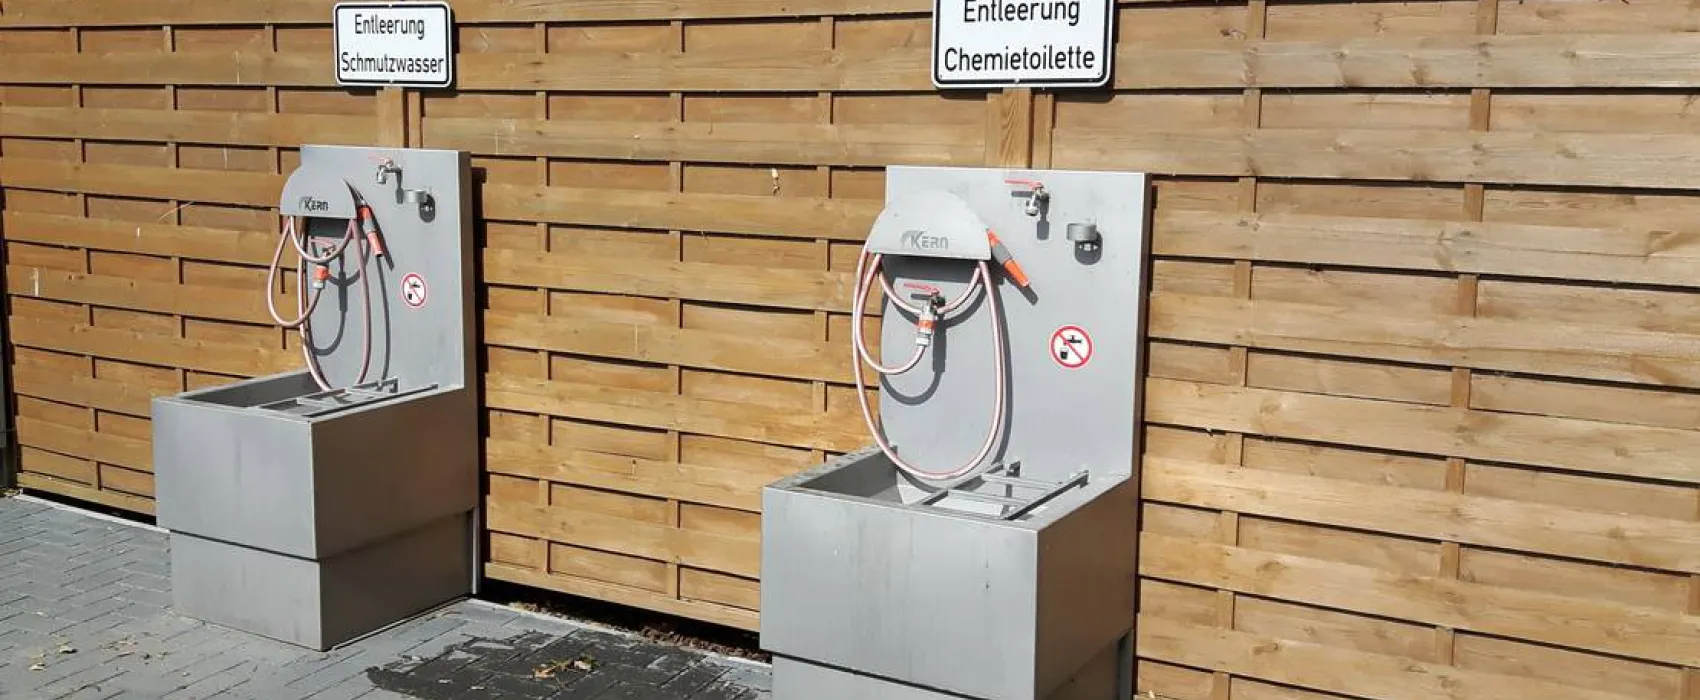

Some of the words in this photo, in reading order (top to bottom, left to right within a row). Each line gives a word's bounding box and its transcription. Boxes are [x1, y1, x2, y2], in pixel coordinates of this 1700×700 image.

[963, 0, 1080, 26] Entleerung
[354, 13, 425, 40] Entleerung
[341, 51, 444, 73] Schmutzwasser
[944, 45, 1095, 71] Chemietoilette
